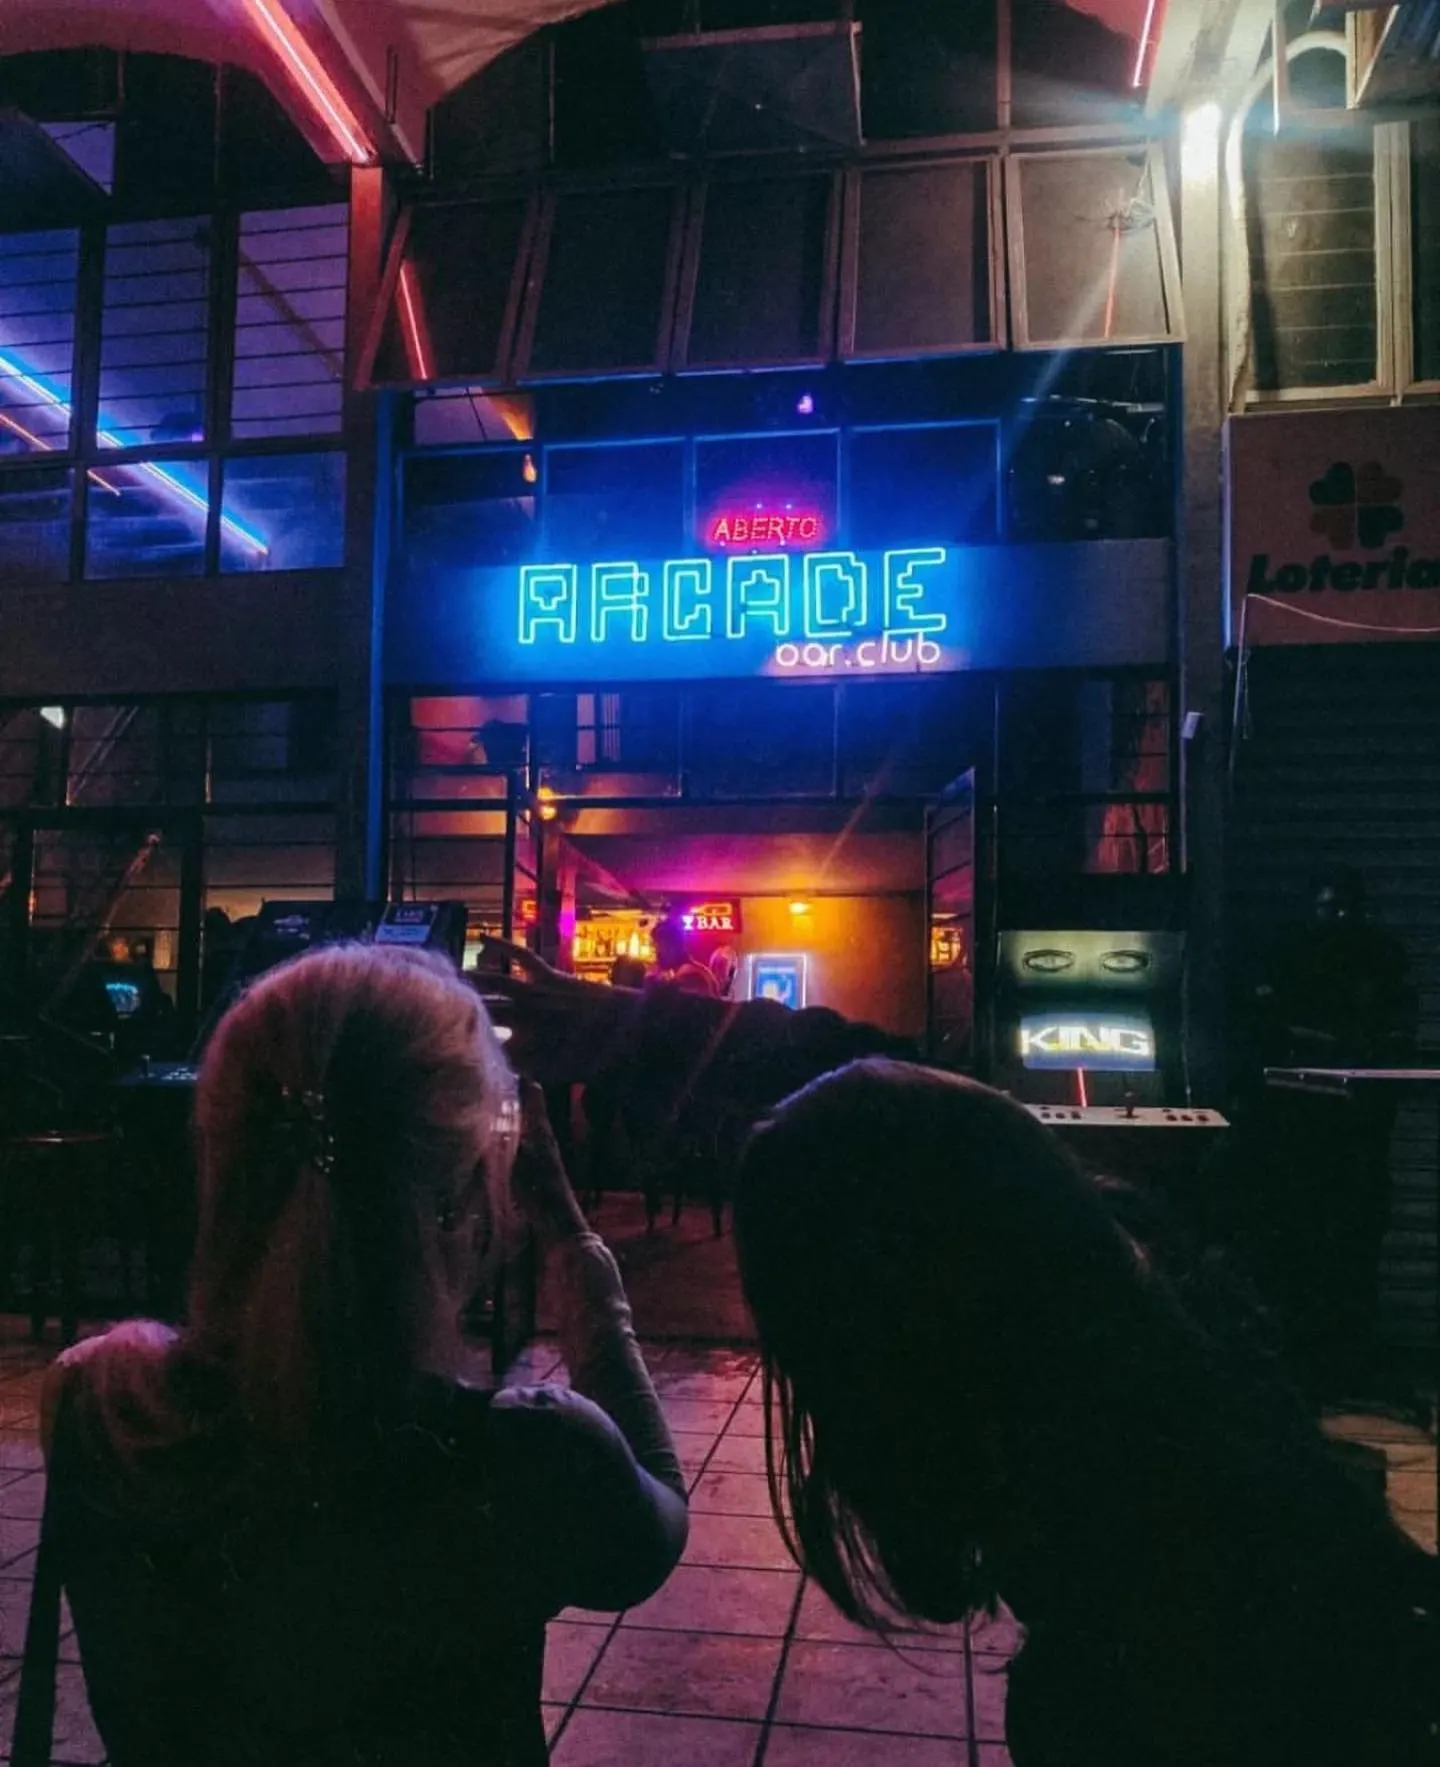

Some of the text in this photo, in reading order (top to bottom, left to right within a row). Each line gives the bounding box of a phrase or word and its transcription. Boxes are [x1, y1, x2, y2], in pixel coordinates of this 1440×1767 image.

[713, 516, 818, 541] ABERTO
[518, 546, 947, 644] ARCADE
[697, 914, 734, 931] BAR
[1020, 1025, 1152, 1056] KING
